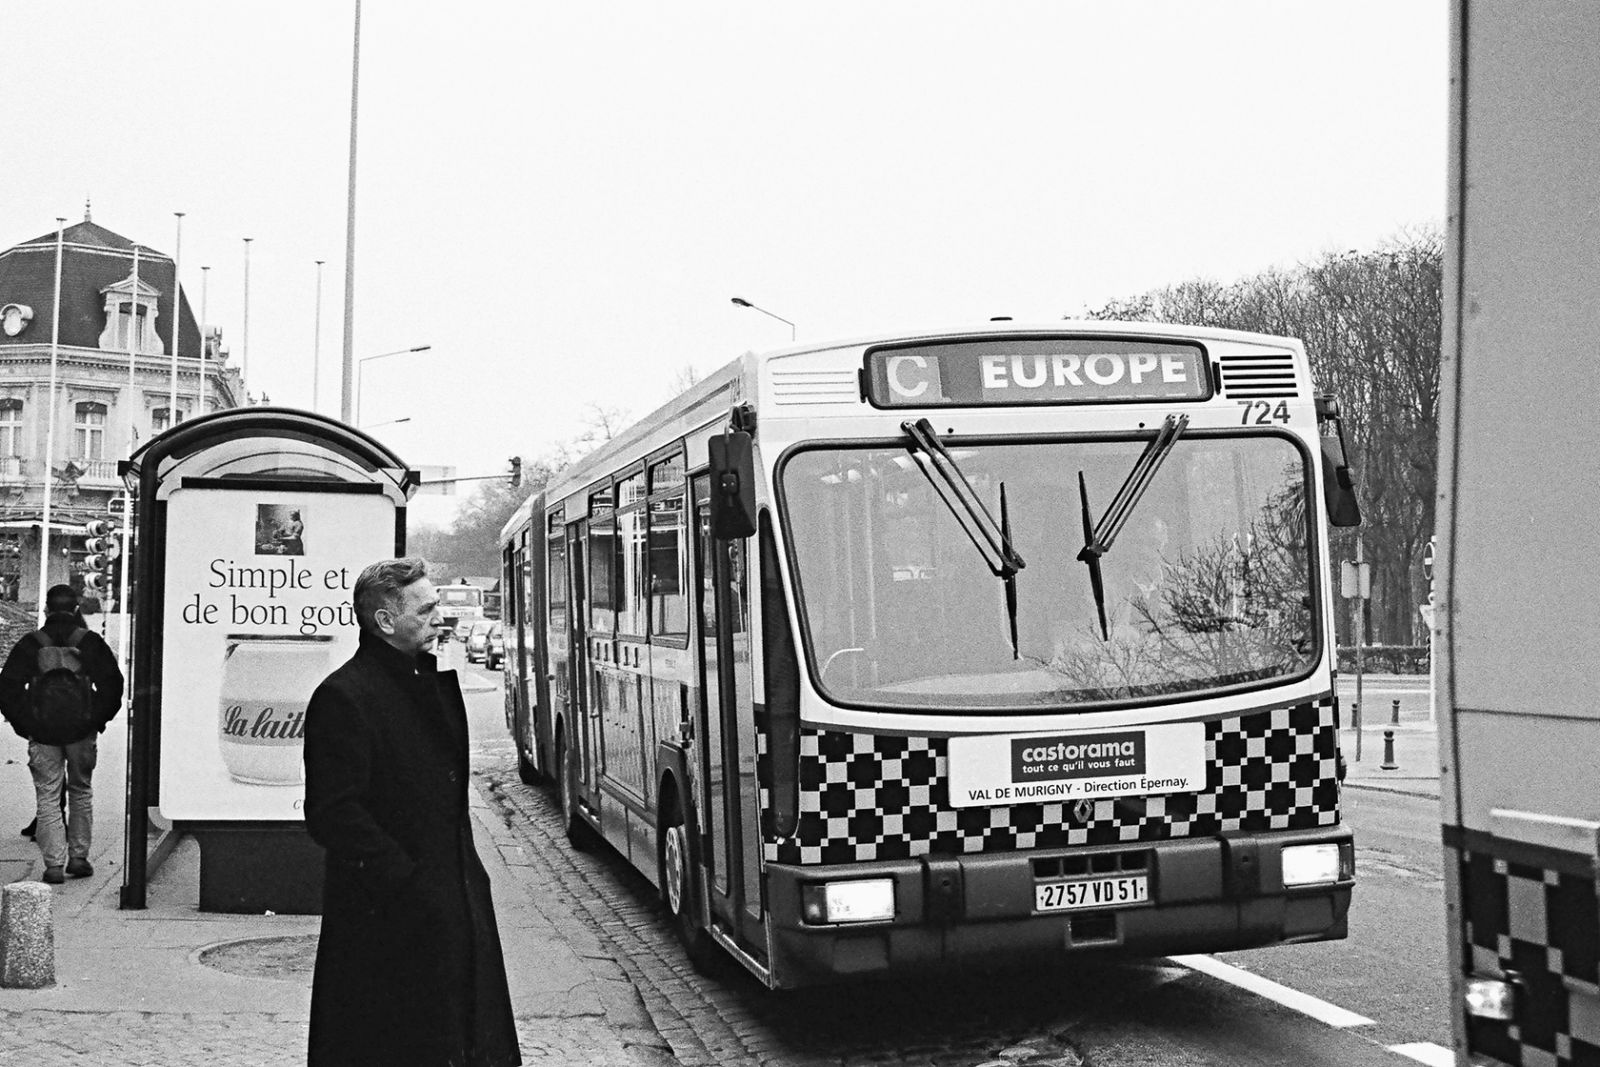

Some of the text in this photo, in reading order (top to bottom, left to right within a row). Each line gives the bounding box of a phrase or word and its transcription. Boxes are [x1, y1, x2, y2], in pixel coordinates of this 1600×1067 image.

[887, 353, 1187, 398] C EUROPE
[1237, 400, 1291, 425] 724
[209, 558, 350, 598] Simple et
[182, 593, 355, 635] de bon goû
[223, 705, 249, 737] La
[1021, 741, 1135, 763] castorama
[1022, 758, 1136, 774] tout ce qu'il vous faut
[969, 789, 991, 801] VAL
[995, 787, 1010, 799] DE
[1015, 783, 1073, 798] MURIGNY
[1084, 780, 1137, 793] Direction
[1141, 776, 1189, 790] Épernay.
[1044, 879, 1138, 907] 2757 VD 51
